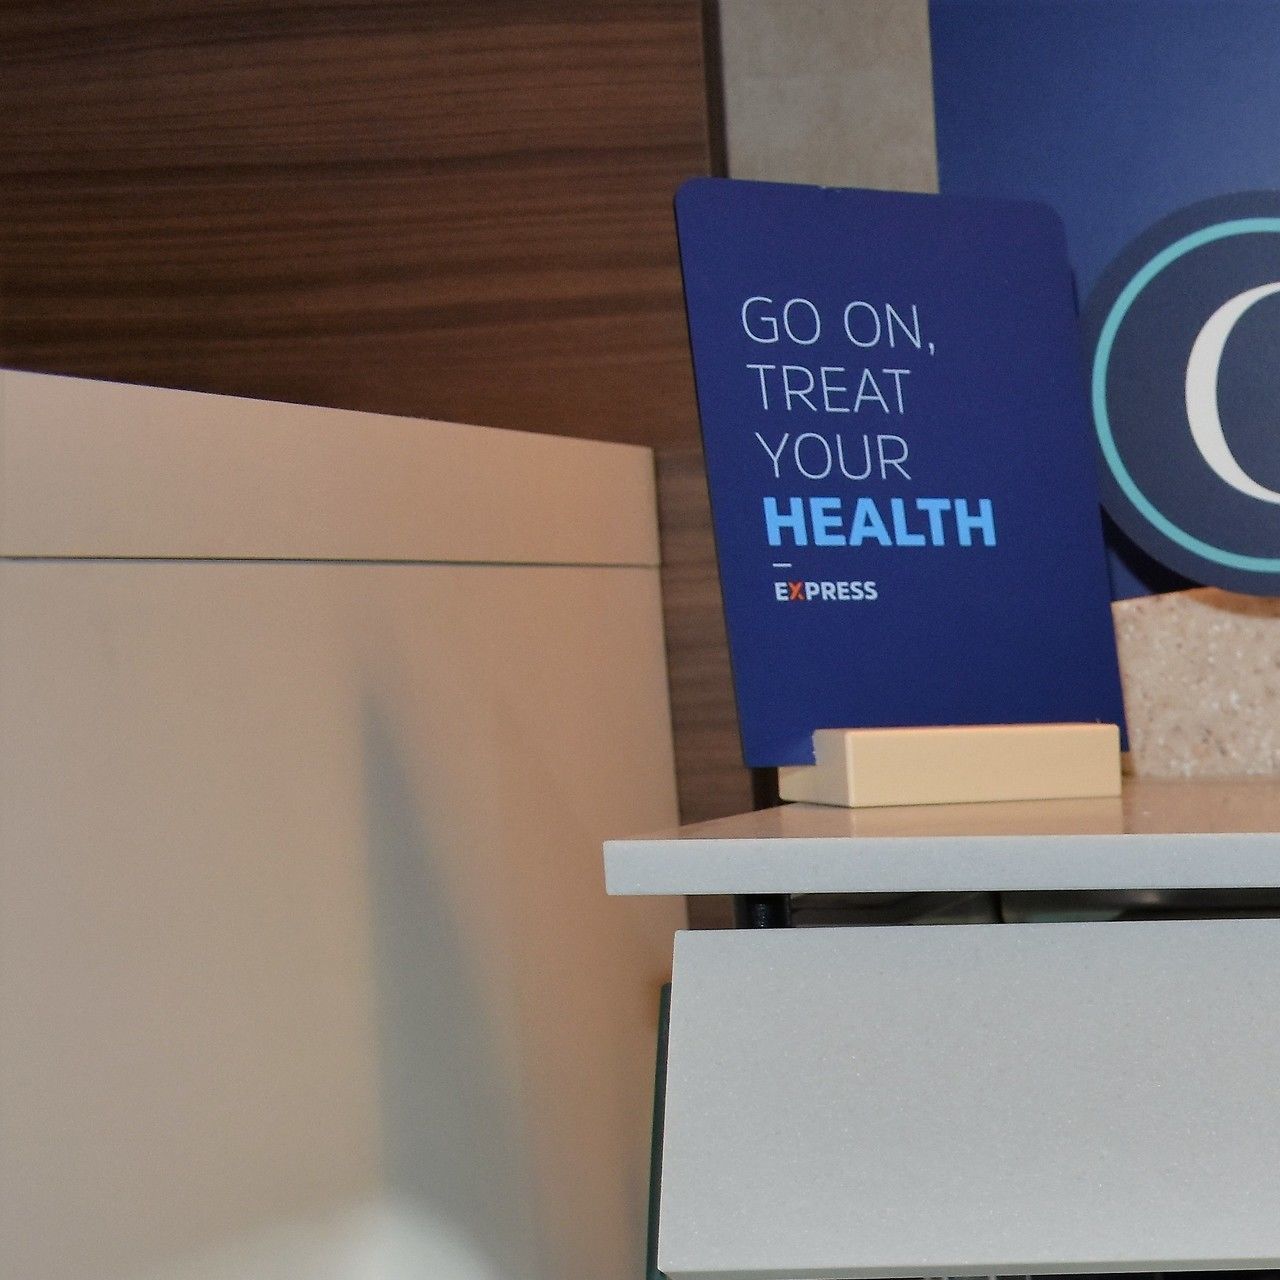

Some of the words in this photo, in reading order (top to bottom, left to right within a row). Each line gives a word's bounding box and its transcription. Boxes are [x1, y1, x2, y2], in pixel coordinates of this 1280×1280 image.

[742, 296, 821, 345] GO
[844, 301, 935, 355] ON,
[746, 364, 911, 414] TREAT
[756, 433, 911, 480] YOUR
[763, 497, 996, 547] HEALTH
[774, 581, 878, 601] EXPRESS
